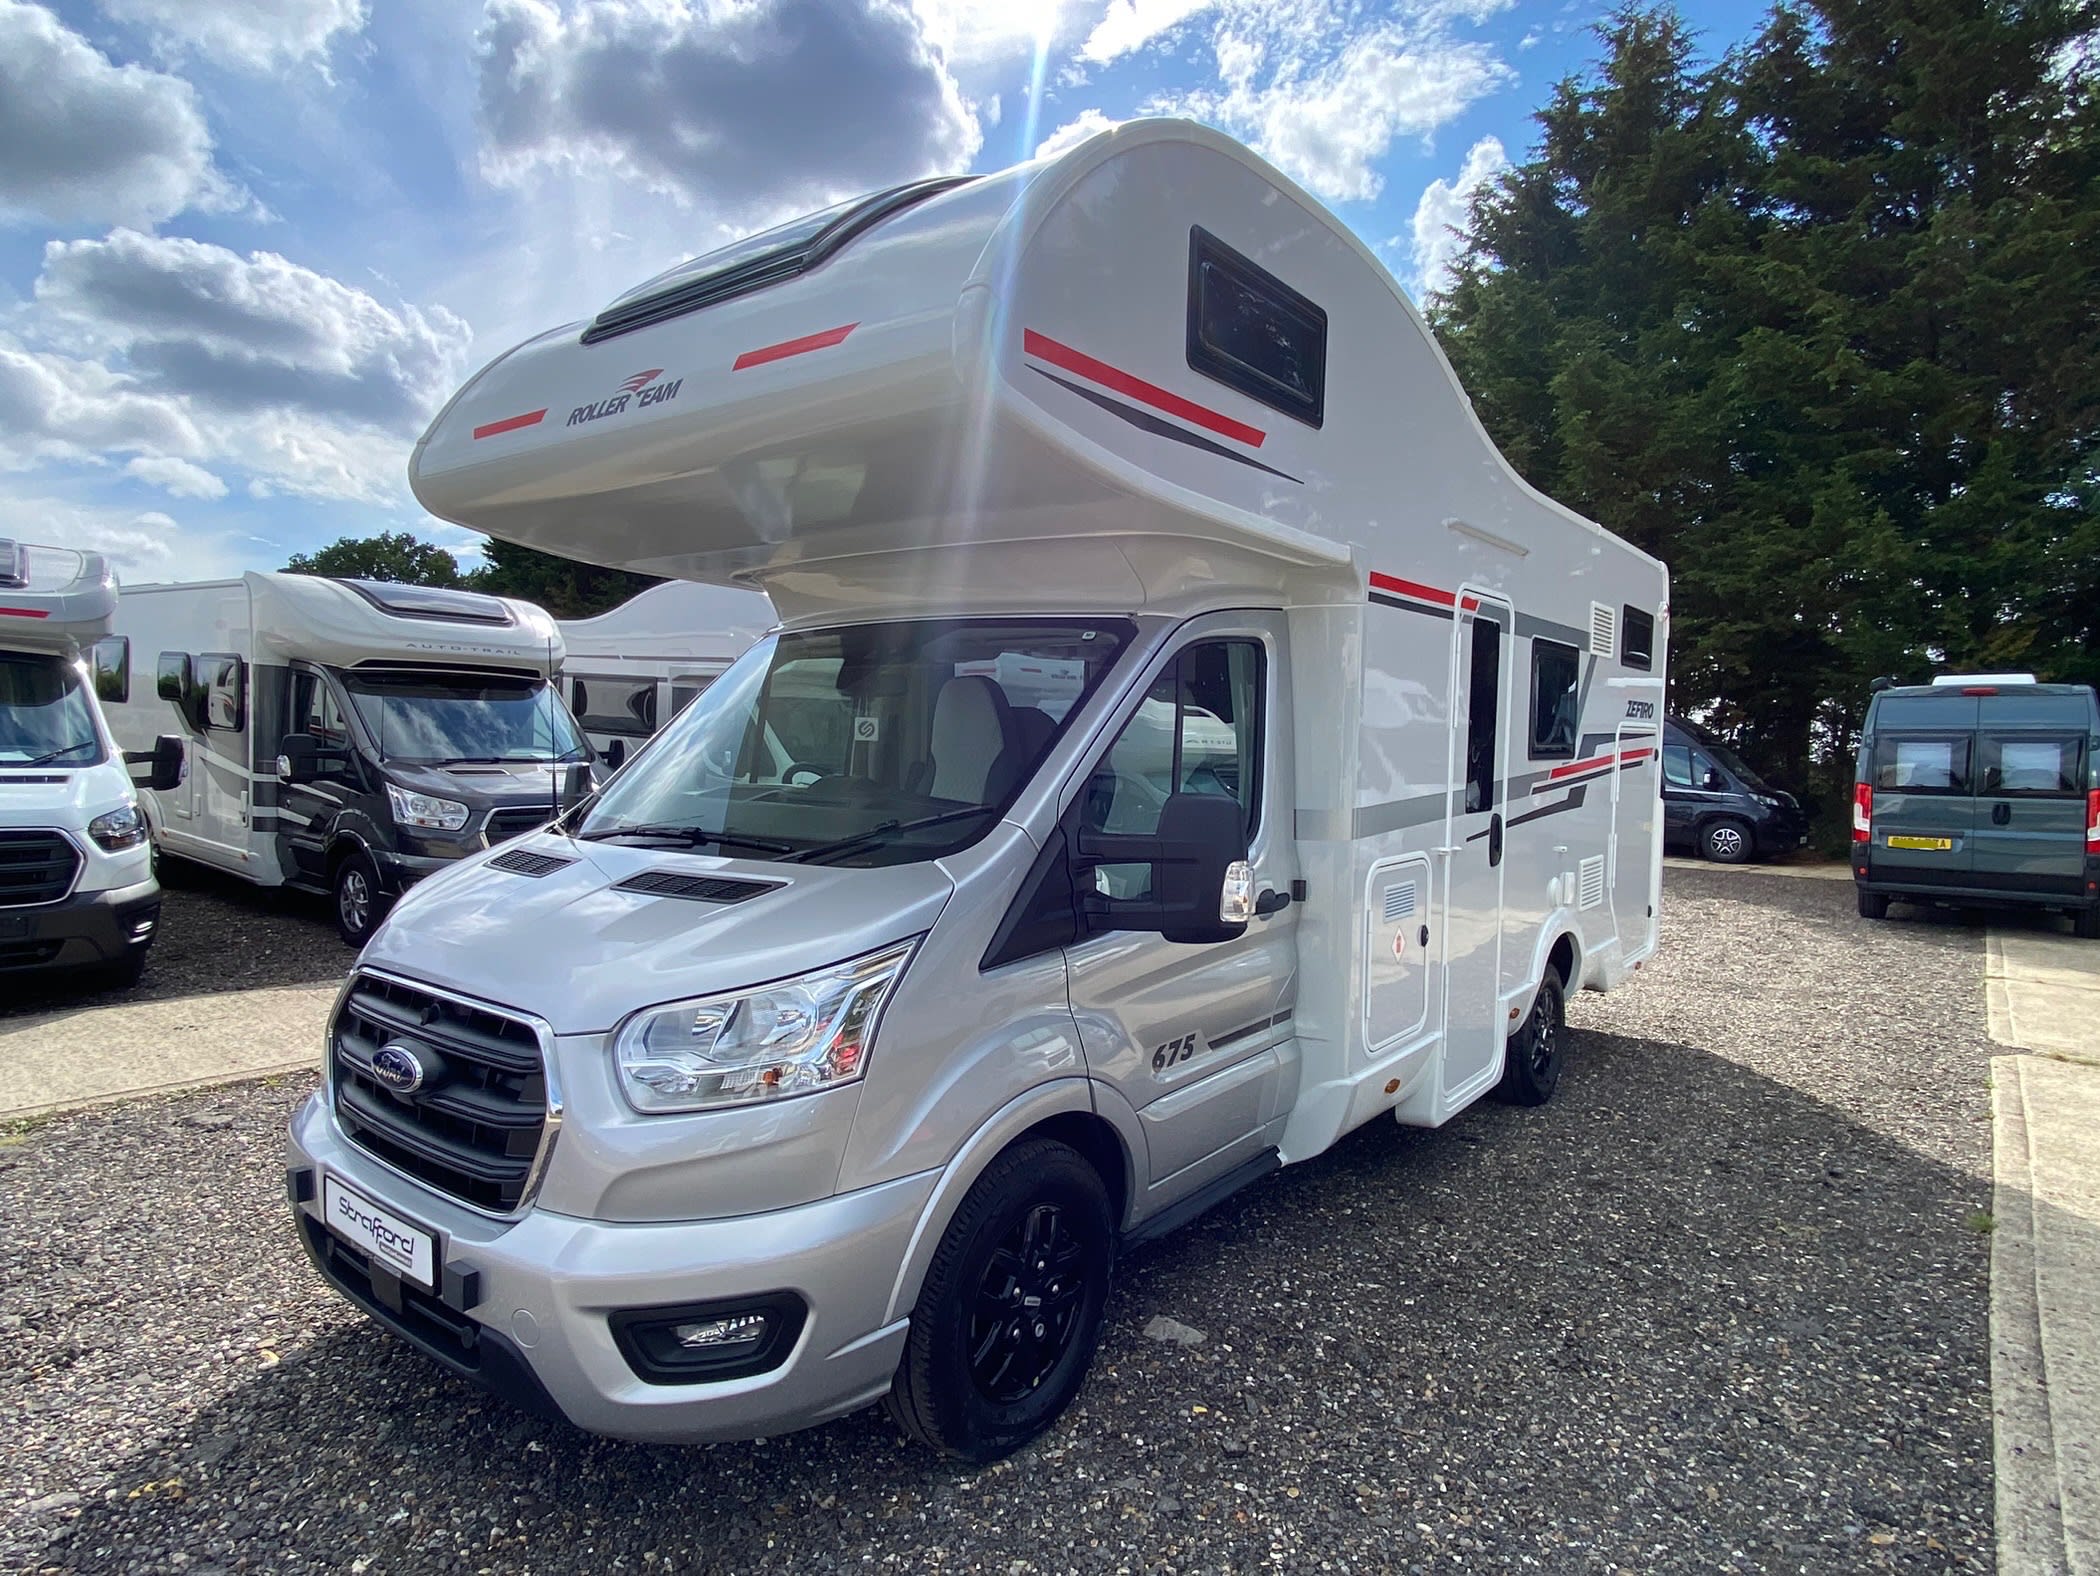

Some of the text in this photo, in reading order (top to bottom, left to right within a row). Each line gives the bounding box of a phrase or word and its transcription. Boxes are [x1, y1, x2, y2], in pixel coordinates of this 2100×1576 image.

[566, 377, 684, 427] ROLLER TEAM
[405, 642, 521, 656] AUTO-TRAIL
[1625, 700, 1655, 720] ZEFIRO
[1151, 1032, 1197, 1074] 675
[338, 1195, 415, 1256] Strafford
